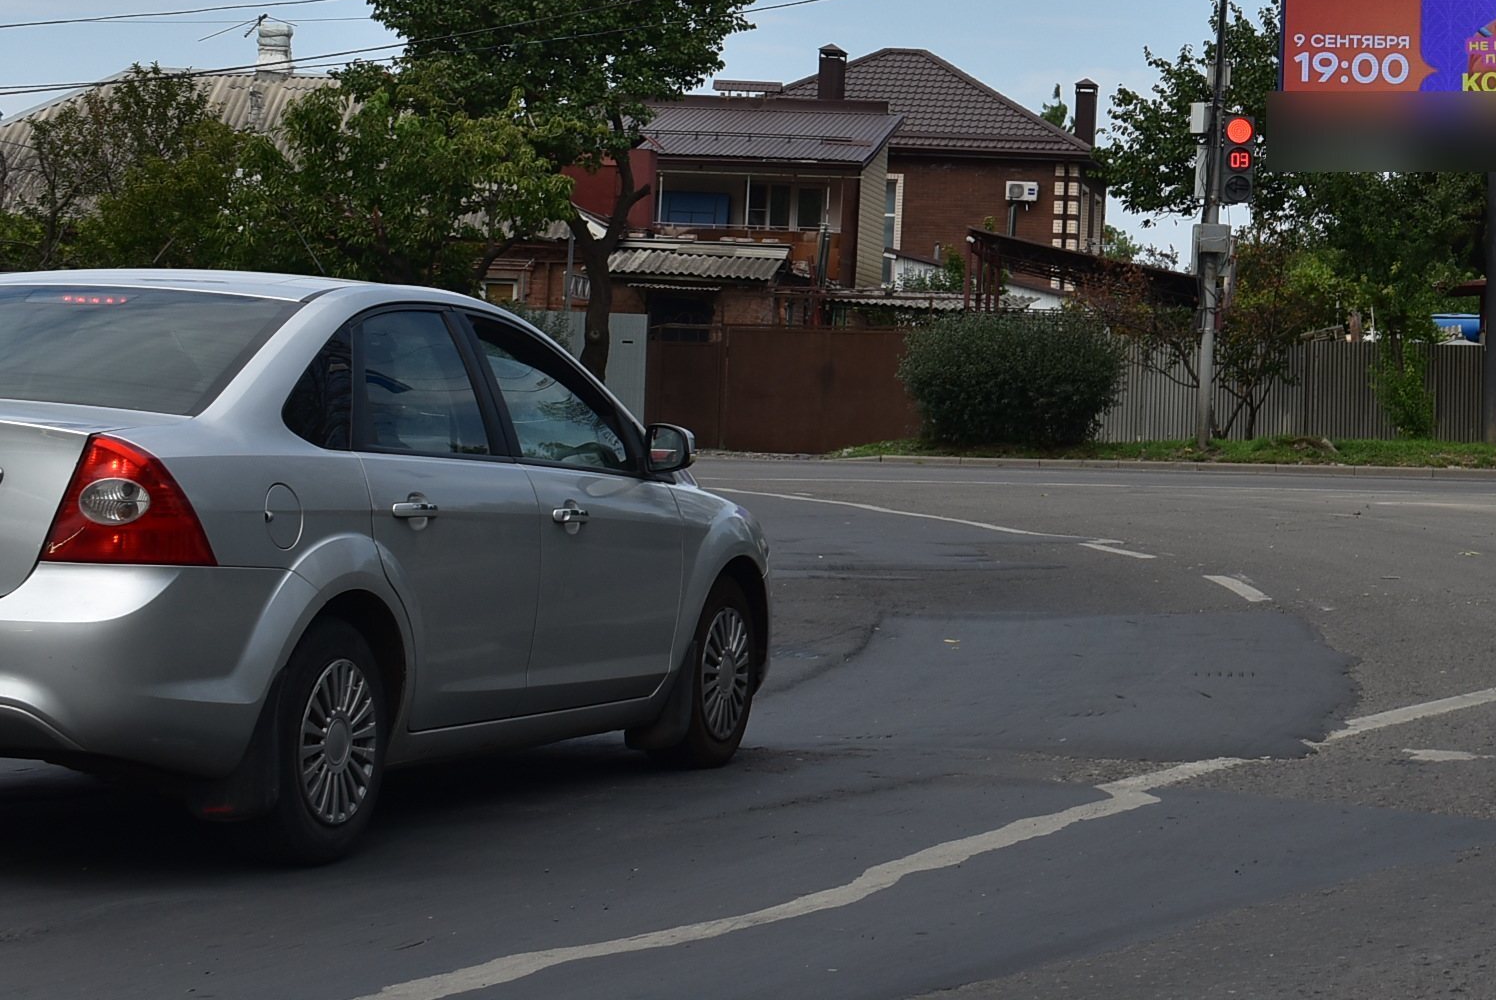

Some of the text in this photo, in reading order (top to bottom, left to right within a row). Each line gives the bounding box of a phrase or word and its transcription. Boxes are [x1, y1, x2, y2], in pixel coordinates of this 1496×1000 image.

[1293, 33, 1410, 49] 9 СЕНТЯБРЯ
[1468, 41, 1489, 51] НЕ
[1293, 51, 1410, 85] 19:00
